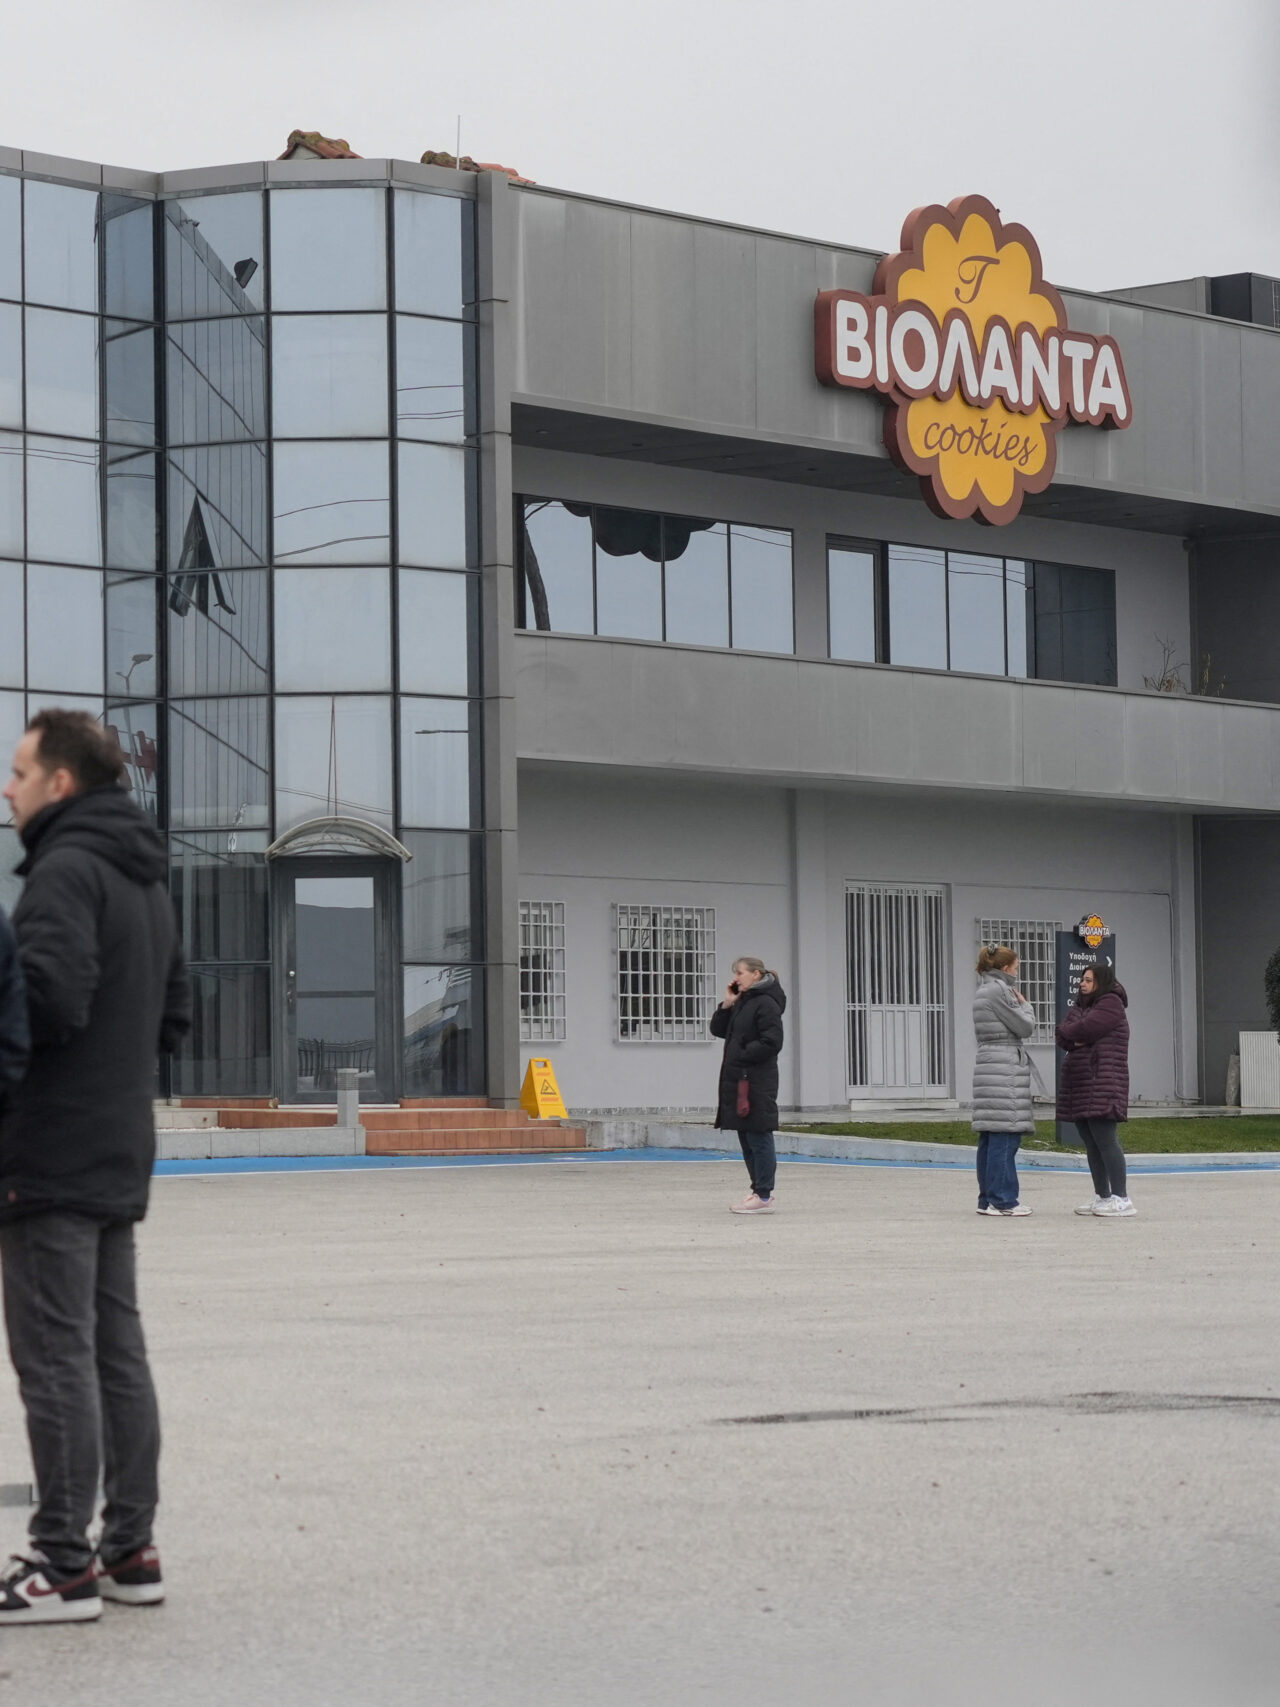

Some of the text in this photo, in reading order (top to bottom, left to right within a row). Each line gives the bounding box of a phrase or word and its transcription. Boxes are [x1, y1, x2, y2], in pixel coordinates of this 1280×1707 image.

[835, 299, 1128, 421] ΒΙΟΛΑΝΤΑ
[923, 417, 1038, 467] cookies
[1079, 926, 1110, 936] ΒΙΟΛΑΝΤΑ
[1069, 952, 1097, 962] Υποδοχή
